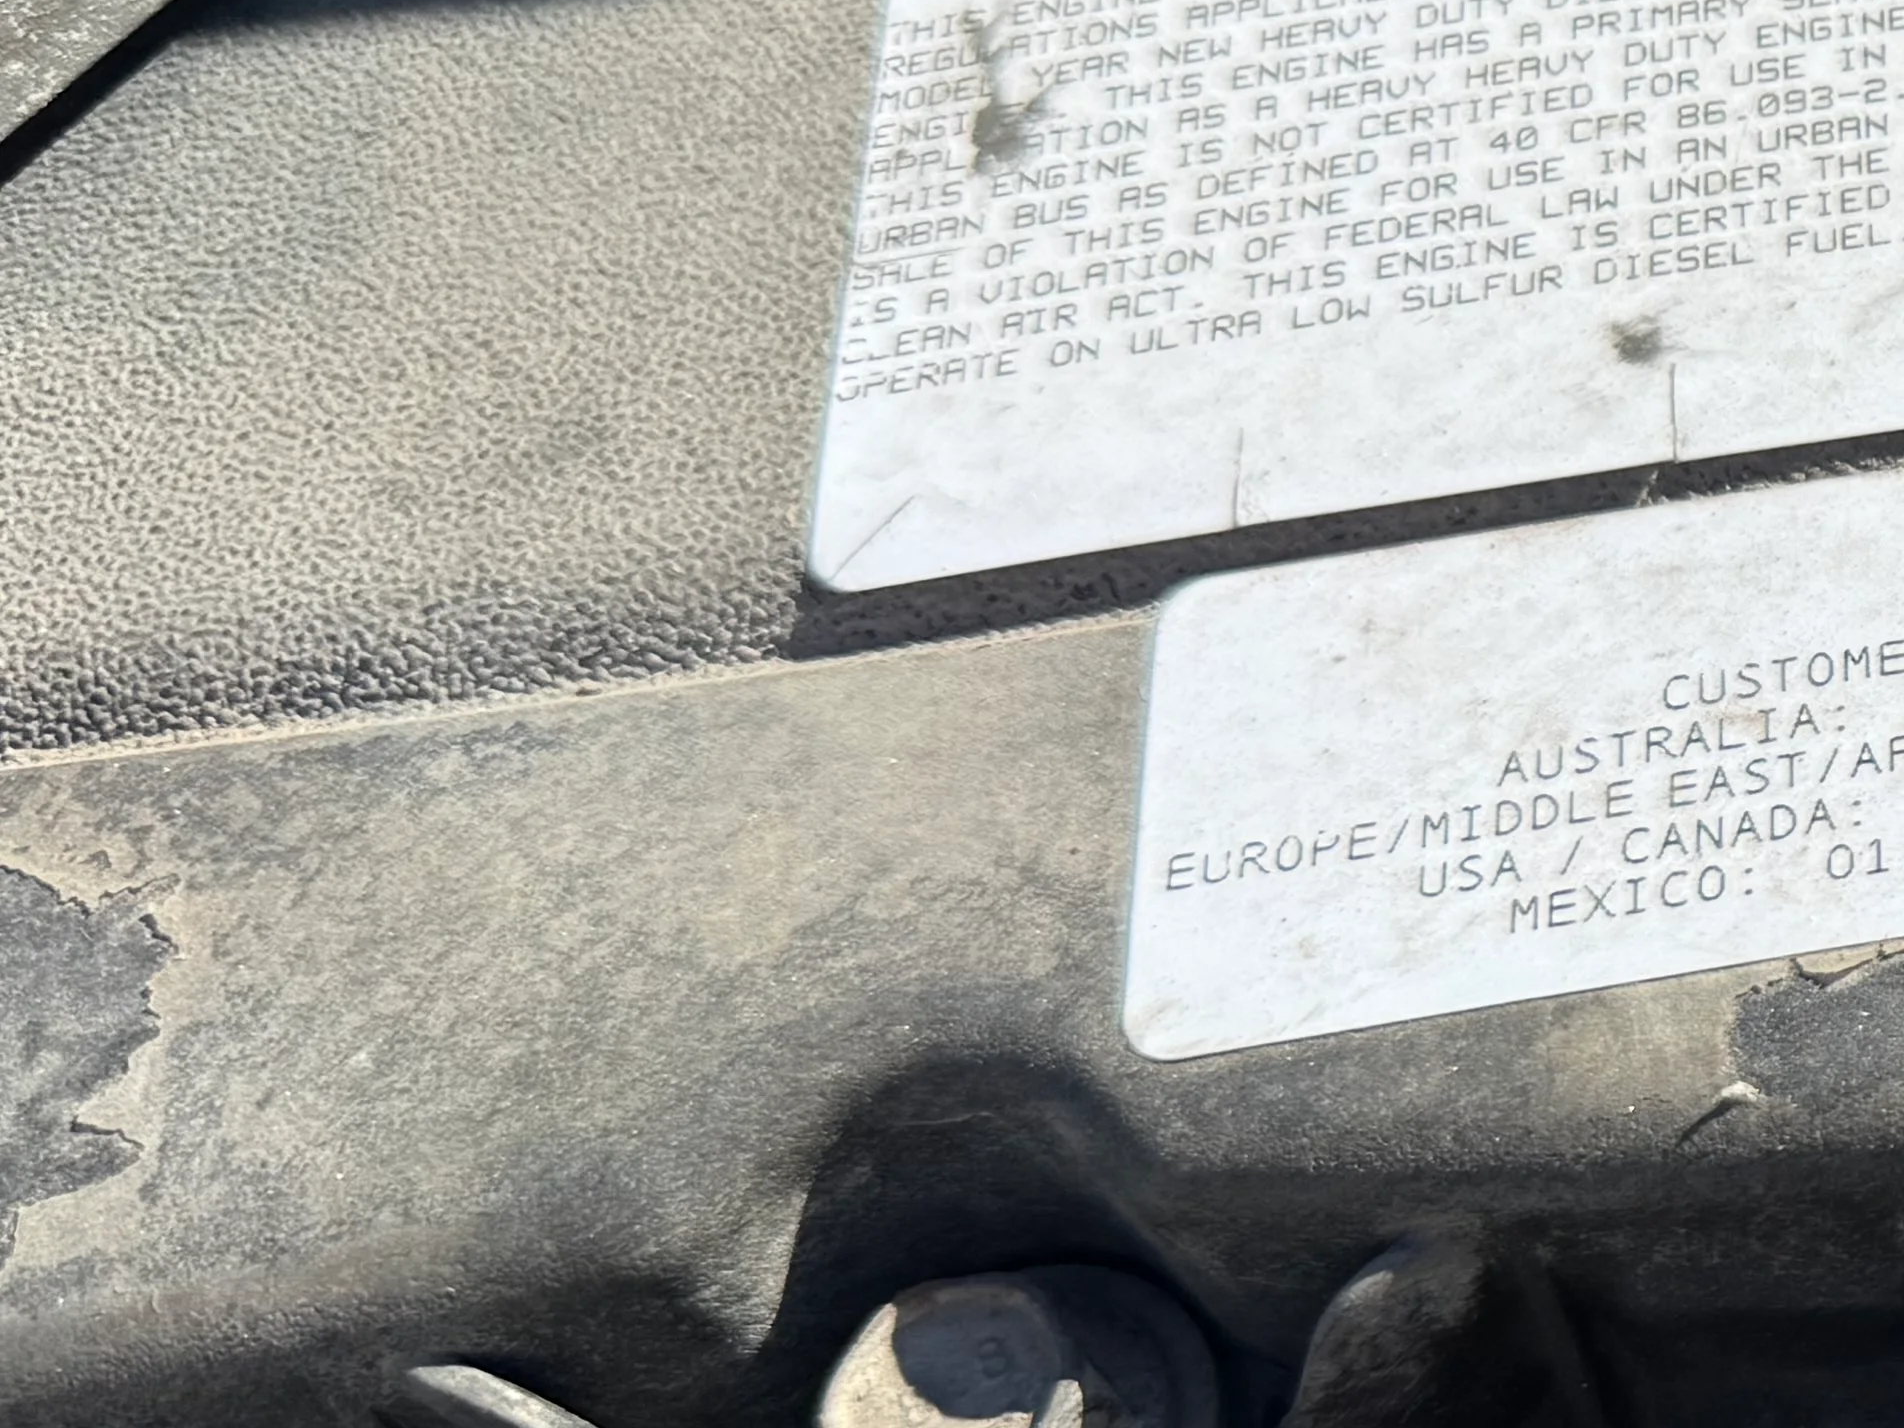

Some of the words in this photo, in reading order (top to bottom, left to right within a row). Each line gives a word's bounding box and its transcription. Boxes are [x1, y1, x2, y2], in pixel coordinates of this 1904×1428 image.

[876, 70, 1002, 115] MODEL
[1027, 49, 1130, 90] YEAR
[1152, 32, 1233, 70] NEW
[1257, 9, 1388, 54] HEAVY
[887, 6, 988, 47] THIS
[1100, 70, 1204, 112] THIS
[1227, 42, 1386, 92] ENGINE
[1411, 27, 1490, 65] HAS
[1517, 18, 1543, 49] A
[863, 178, 964, 220] THIS
[988, 149, 1146, 199] ENGINE
[1175, 136, 1224, 170] IS
[1247, 119, 1328, 158] NOT
[1354, 79, 1594, 142] CERTIFIED
[1621, 65, 1700, 104] FOR
[1728, 51, 1806, 90] USE
[1839, 40, 1887, 74] IN
[867, 114, 1150, 183] APPLATION
[1174, 101, 1228, 135] AS
[1251, 93, 1279, 123] A
[1304, 69, 1437, 115] HEAVY
[1463, 46, 1595, 92] HEAVY
[1622, 27, 1727, 70] DUTY
[850, 294, 899, 329] IS
[922, 284, 952, 316] A
[973, 243, 1216, 307] VIOLATION
[1240, 230, 1295, 265] OF
[1322, 198, 1510, 254] FEDERAL
[1537, 182, 1620, 222] LAW
[1647, 160, 1782, 207] UNDER
[1811, 144, 1890, 184] THE
[851, 248, 955, 291] SALE
[977, 236, 1032, 272] OF
[1059, 215, 1166, 258] THIS
[1188, 186, 1350, 238] ENGINE
[1377, 170, 1459, 209] FOR
[1485, 154, 1566, 194] USE
[1598, 143, 1647, 177] IN
[1674, 131, 1728, 167] AN
[1756, 109, 1889, 156] URBAN
[856, 209, 986, 256] URBAN
[1008, 192, 1090, 232] BUS
[1115, 179, 1169, 214] AS
[1194, 147, 1380, 202] DEFINED
[1406, 135, 1459, 170] AT
[1487, 122, 1539, 157] 40
[1563, 107, 1647, 147] CFR
[834, 347, 1021, 403] OPERATE
[1044, 333, 1102, 370] ON
[1125, 308, 1264, 356] ULTRA
[1288, 291, 1372, 331] LOW
[1399, 262, 1564, 315] SULFUR
[1591, 235, 1755, 288] DIESEL
[840, 319, 973, 367] CLEAN
[997, 300, 1079, 340] AIR
[1104, 280, 1206, 323] ACT.
[1239, 258, 1347, 302] THIS
[1373, 230, 1537, 282] ENGINE
[1570, 218, 1619, 253] IS
[1647, 179, 1891, 244] CERTIFIED
[1498, 700, 1848, 787] AUSTRALIA:
[1166, 778, 1635, 891] EUROPE/MIDDLE
[1418, 852, 1521, 898] USA
[1558, 838, 1583, 876] /
[1622, 798, 1864, 865] CANADA:
[1508, 863, 1756, 934] MEXICO:
